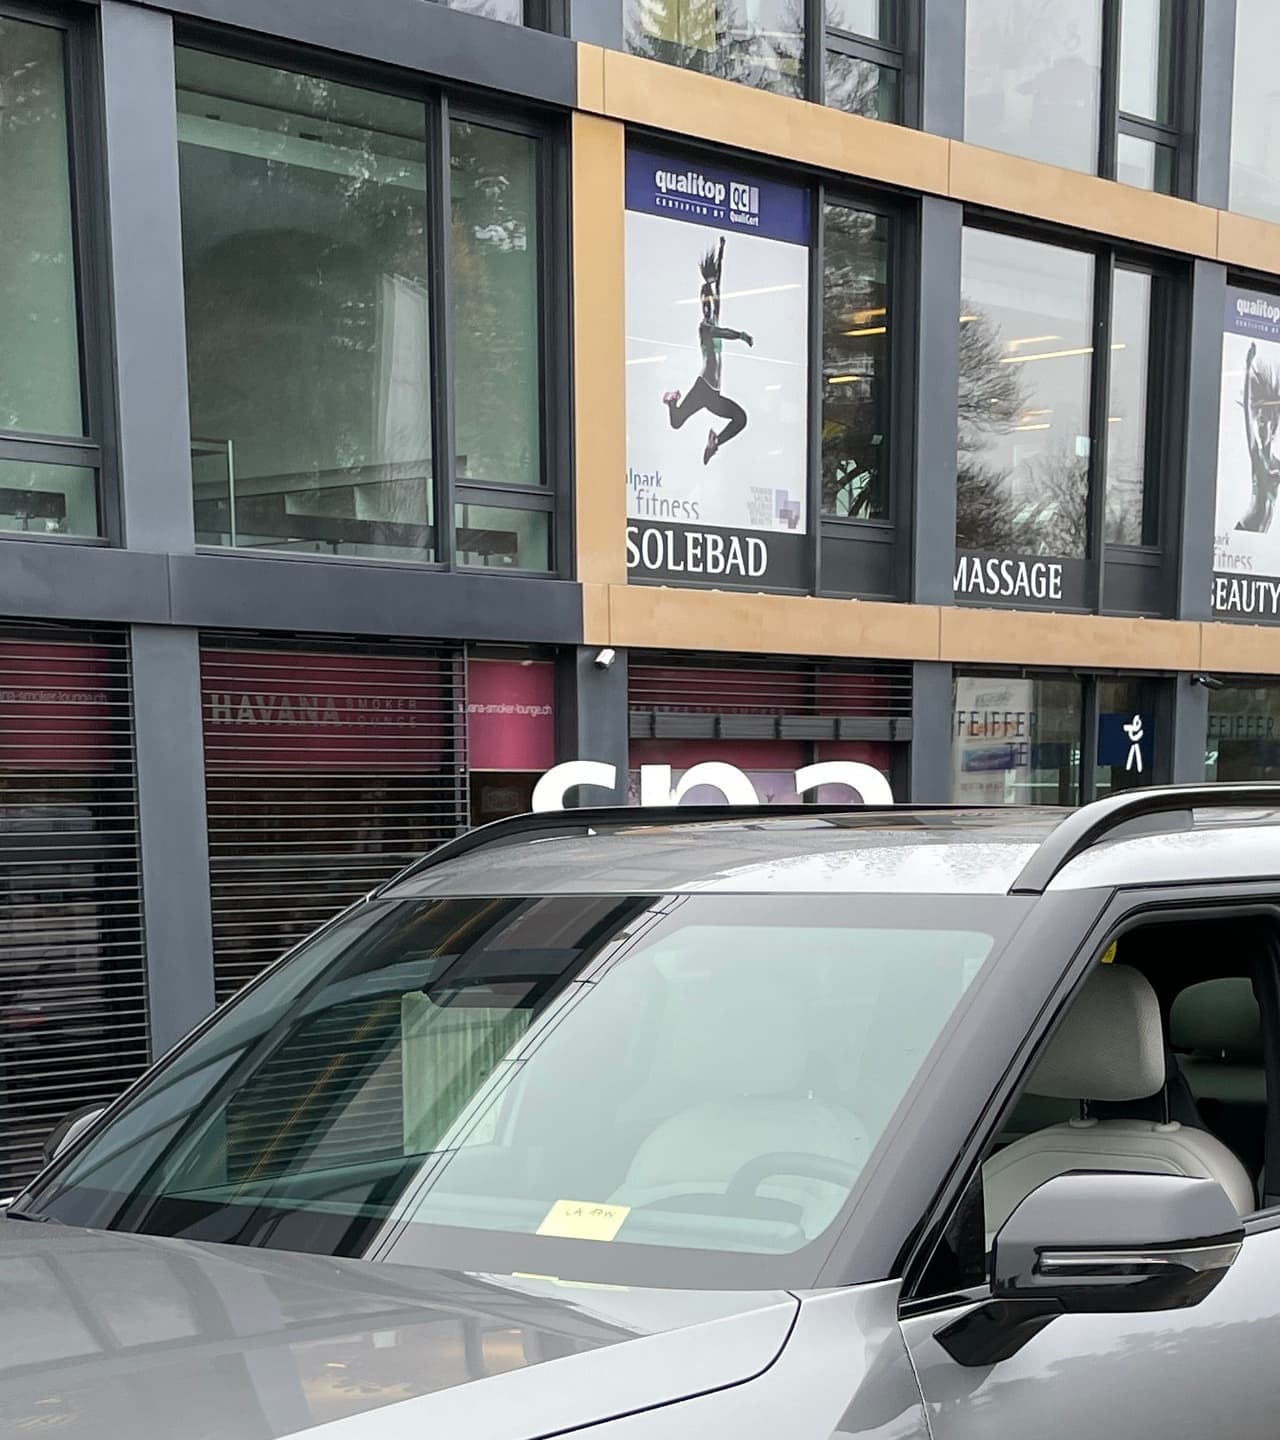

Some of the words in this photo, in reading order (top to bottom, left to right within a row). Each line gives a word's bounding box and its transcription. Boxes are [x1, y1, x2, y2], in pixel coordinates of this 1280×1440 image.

[655, 170, 726, 204] qualitop
[1236, 299, 1280, 323] qualitop
[636, 489, 700, 520] fitness
[626, 527, 768, 577] SOLEBAD
